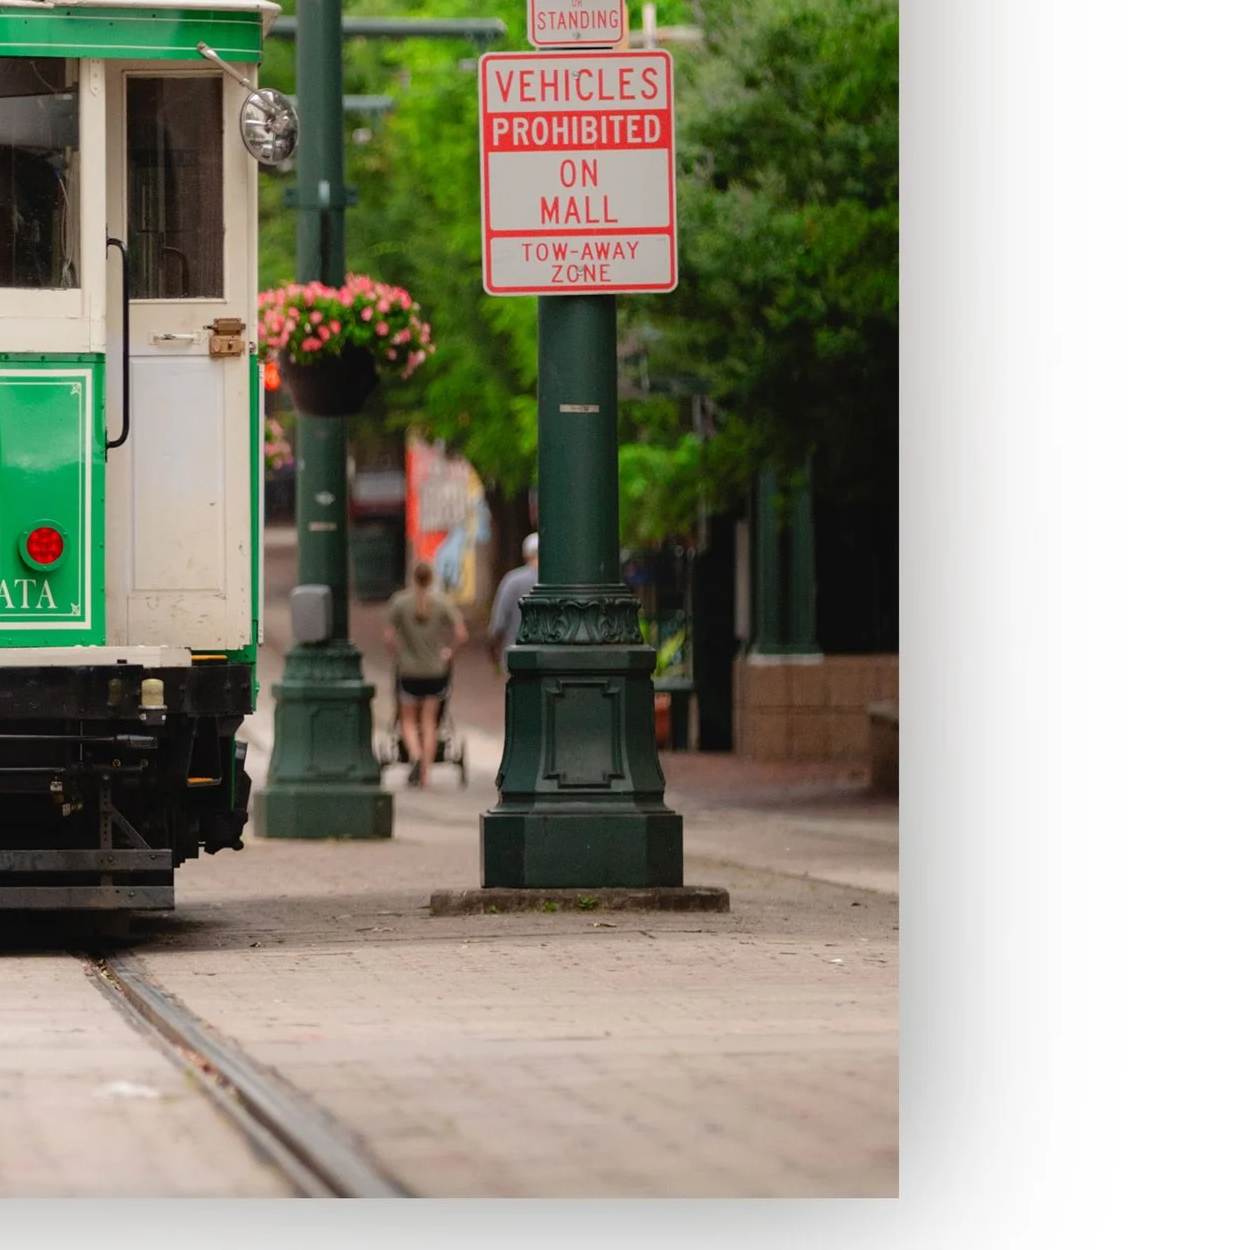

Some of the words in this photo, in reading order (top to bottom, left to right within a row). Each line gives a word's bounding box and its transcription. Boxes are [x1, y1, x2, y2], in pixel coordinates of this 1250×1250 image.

[537, 10, 618, 30] STANDING
[495, 67, 658, 102] VEHICLES
[493, 114, 661, 146] PROHIBITED
[560, 159, 598, 188] ON
[540, 195, 618, 224] MALL
[521, 241, 639, 262] TOW-AWAY
[551, 264, 611, 283] ZONE
